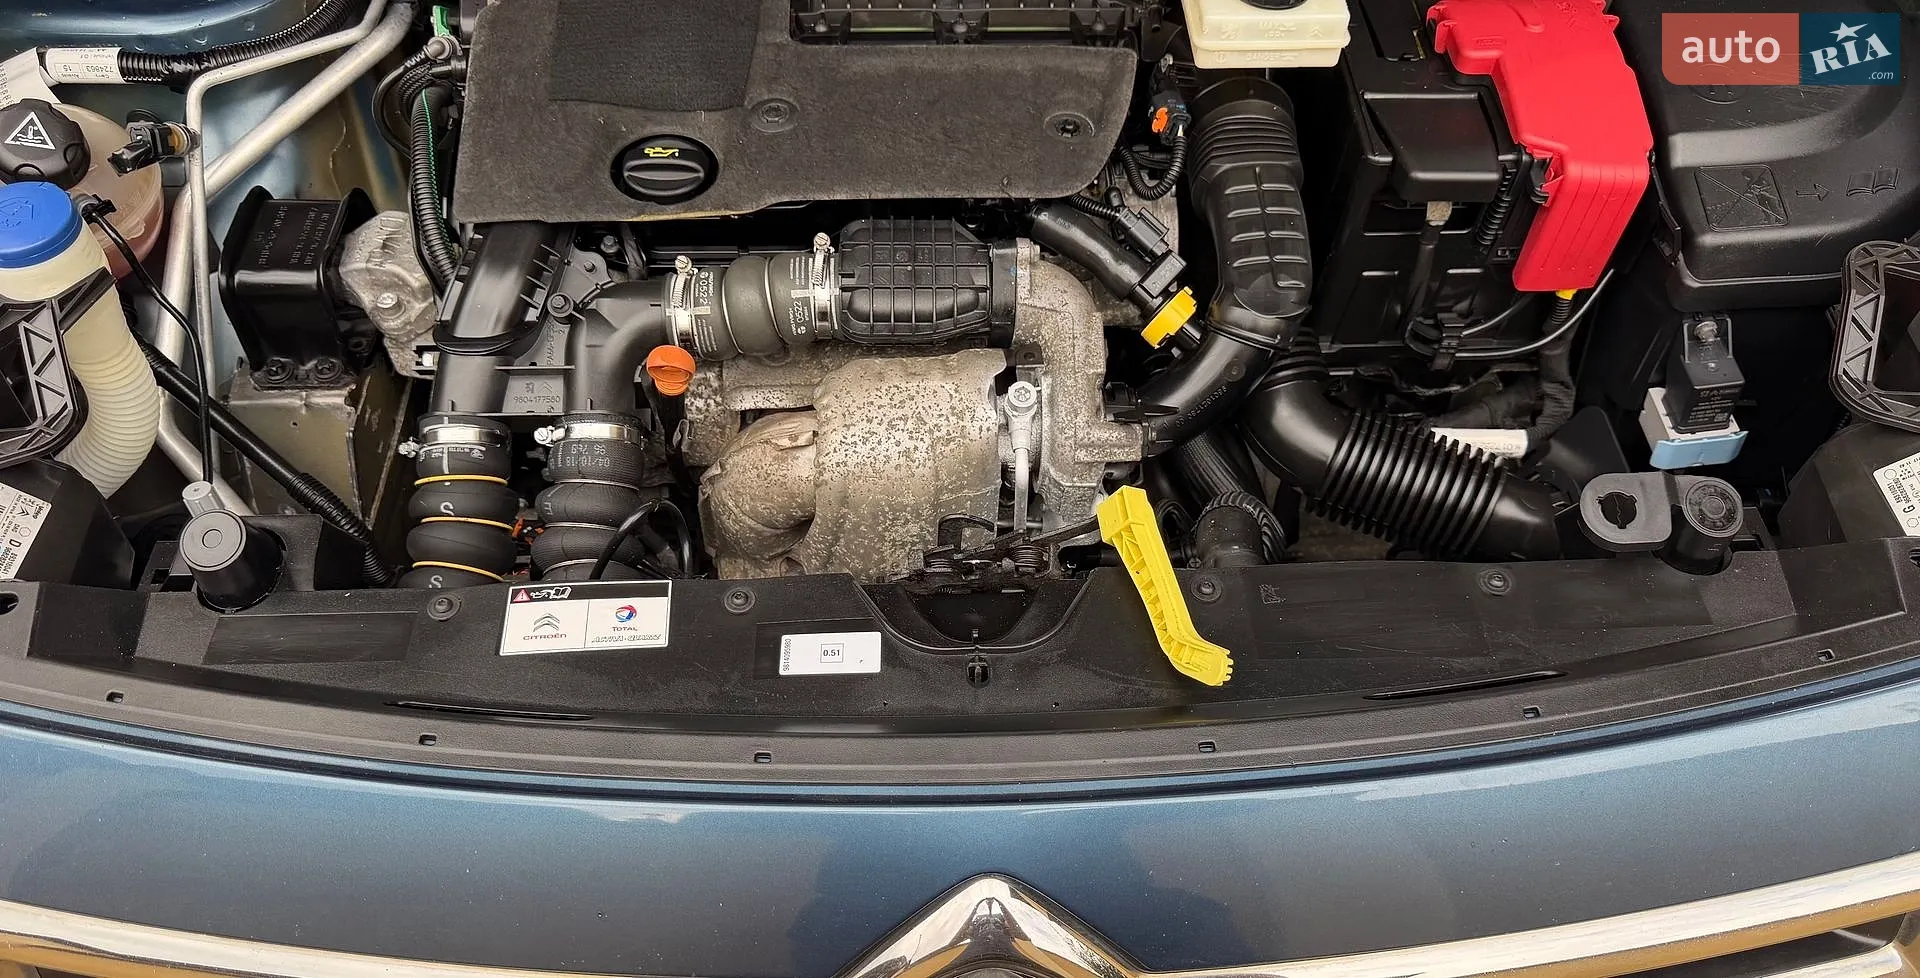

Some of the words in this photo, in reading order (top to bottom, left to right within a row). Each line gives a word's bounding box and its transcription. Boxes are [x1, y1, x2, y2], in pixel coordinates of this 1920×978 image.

[1902, 504, 1916, 514] G
[522, 633, 567, 641] CITROËN
[822, 649, 840, 657] 0.51
